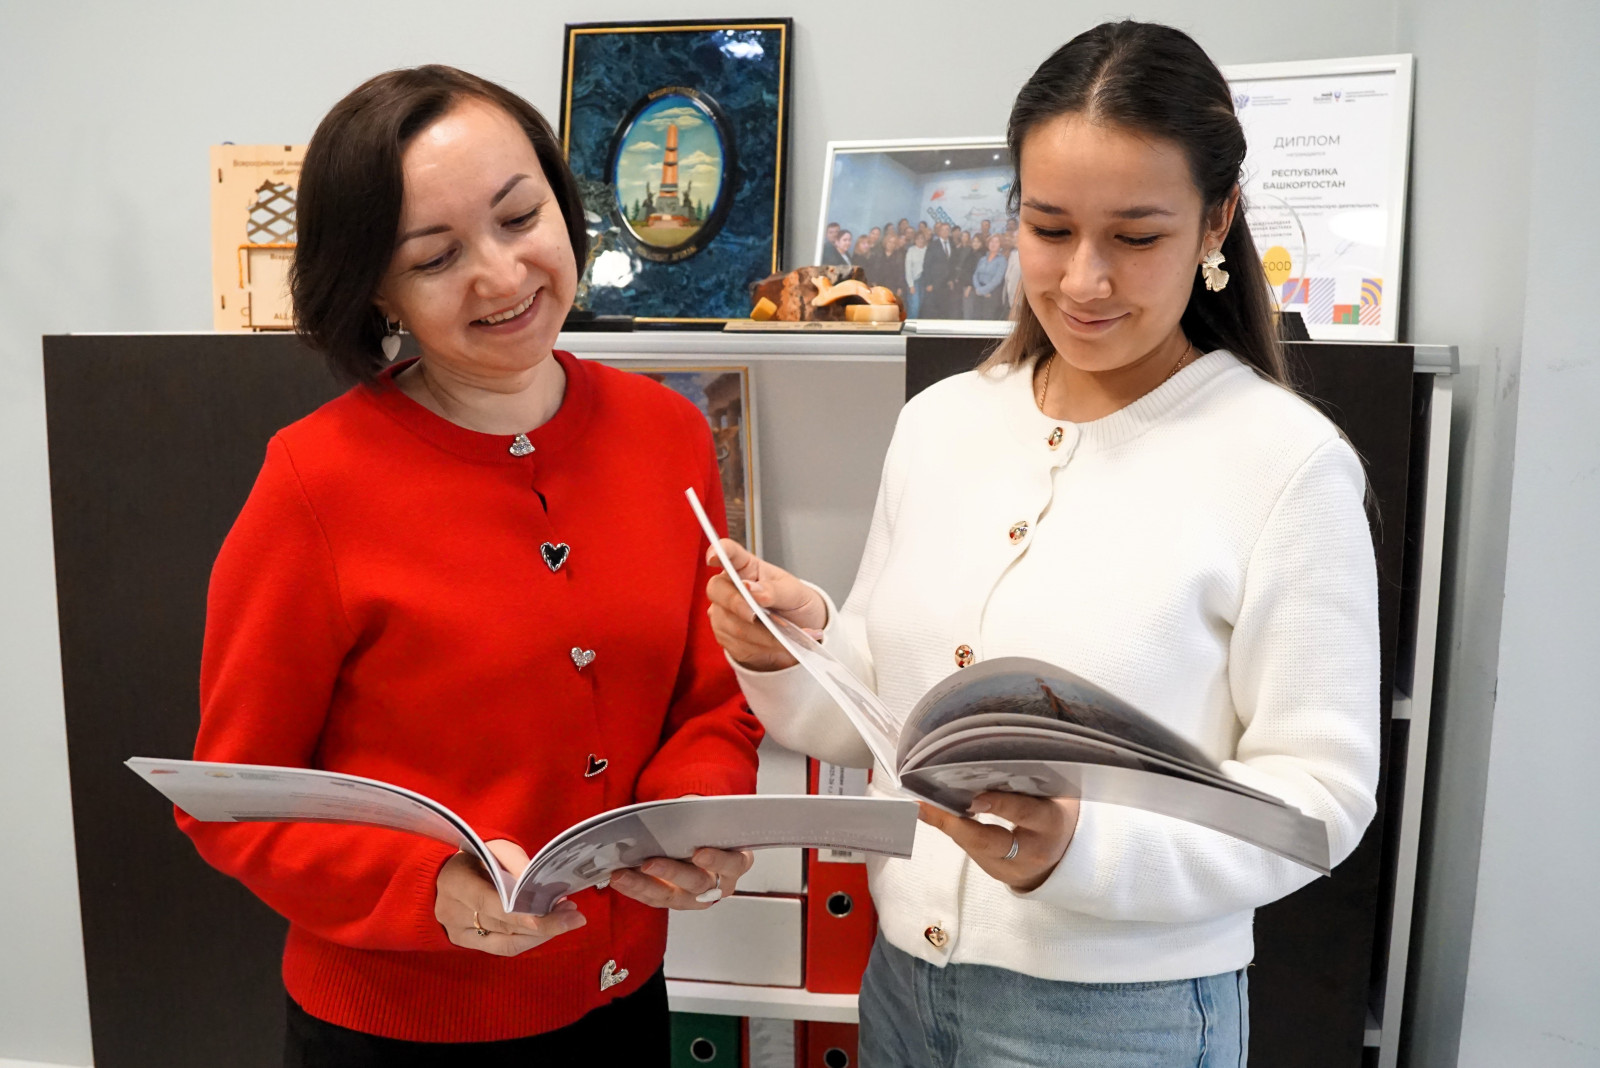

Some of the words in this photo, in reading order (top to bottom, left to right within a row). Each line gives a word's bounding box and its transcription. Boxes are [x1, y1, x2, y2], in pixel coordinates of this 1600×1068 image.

[1273, 135, 1341, 149] ДИПЛОМ
[1271, 168, 1338, 178] РЕСПУБЛИКА
[1262, 180, 1346, 190] БАШКОРТОСТАН
